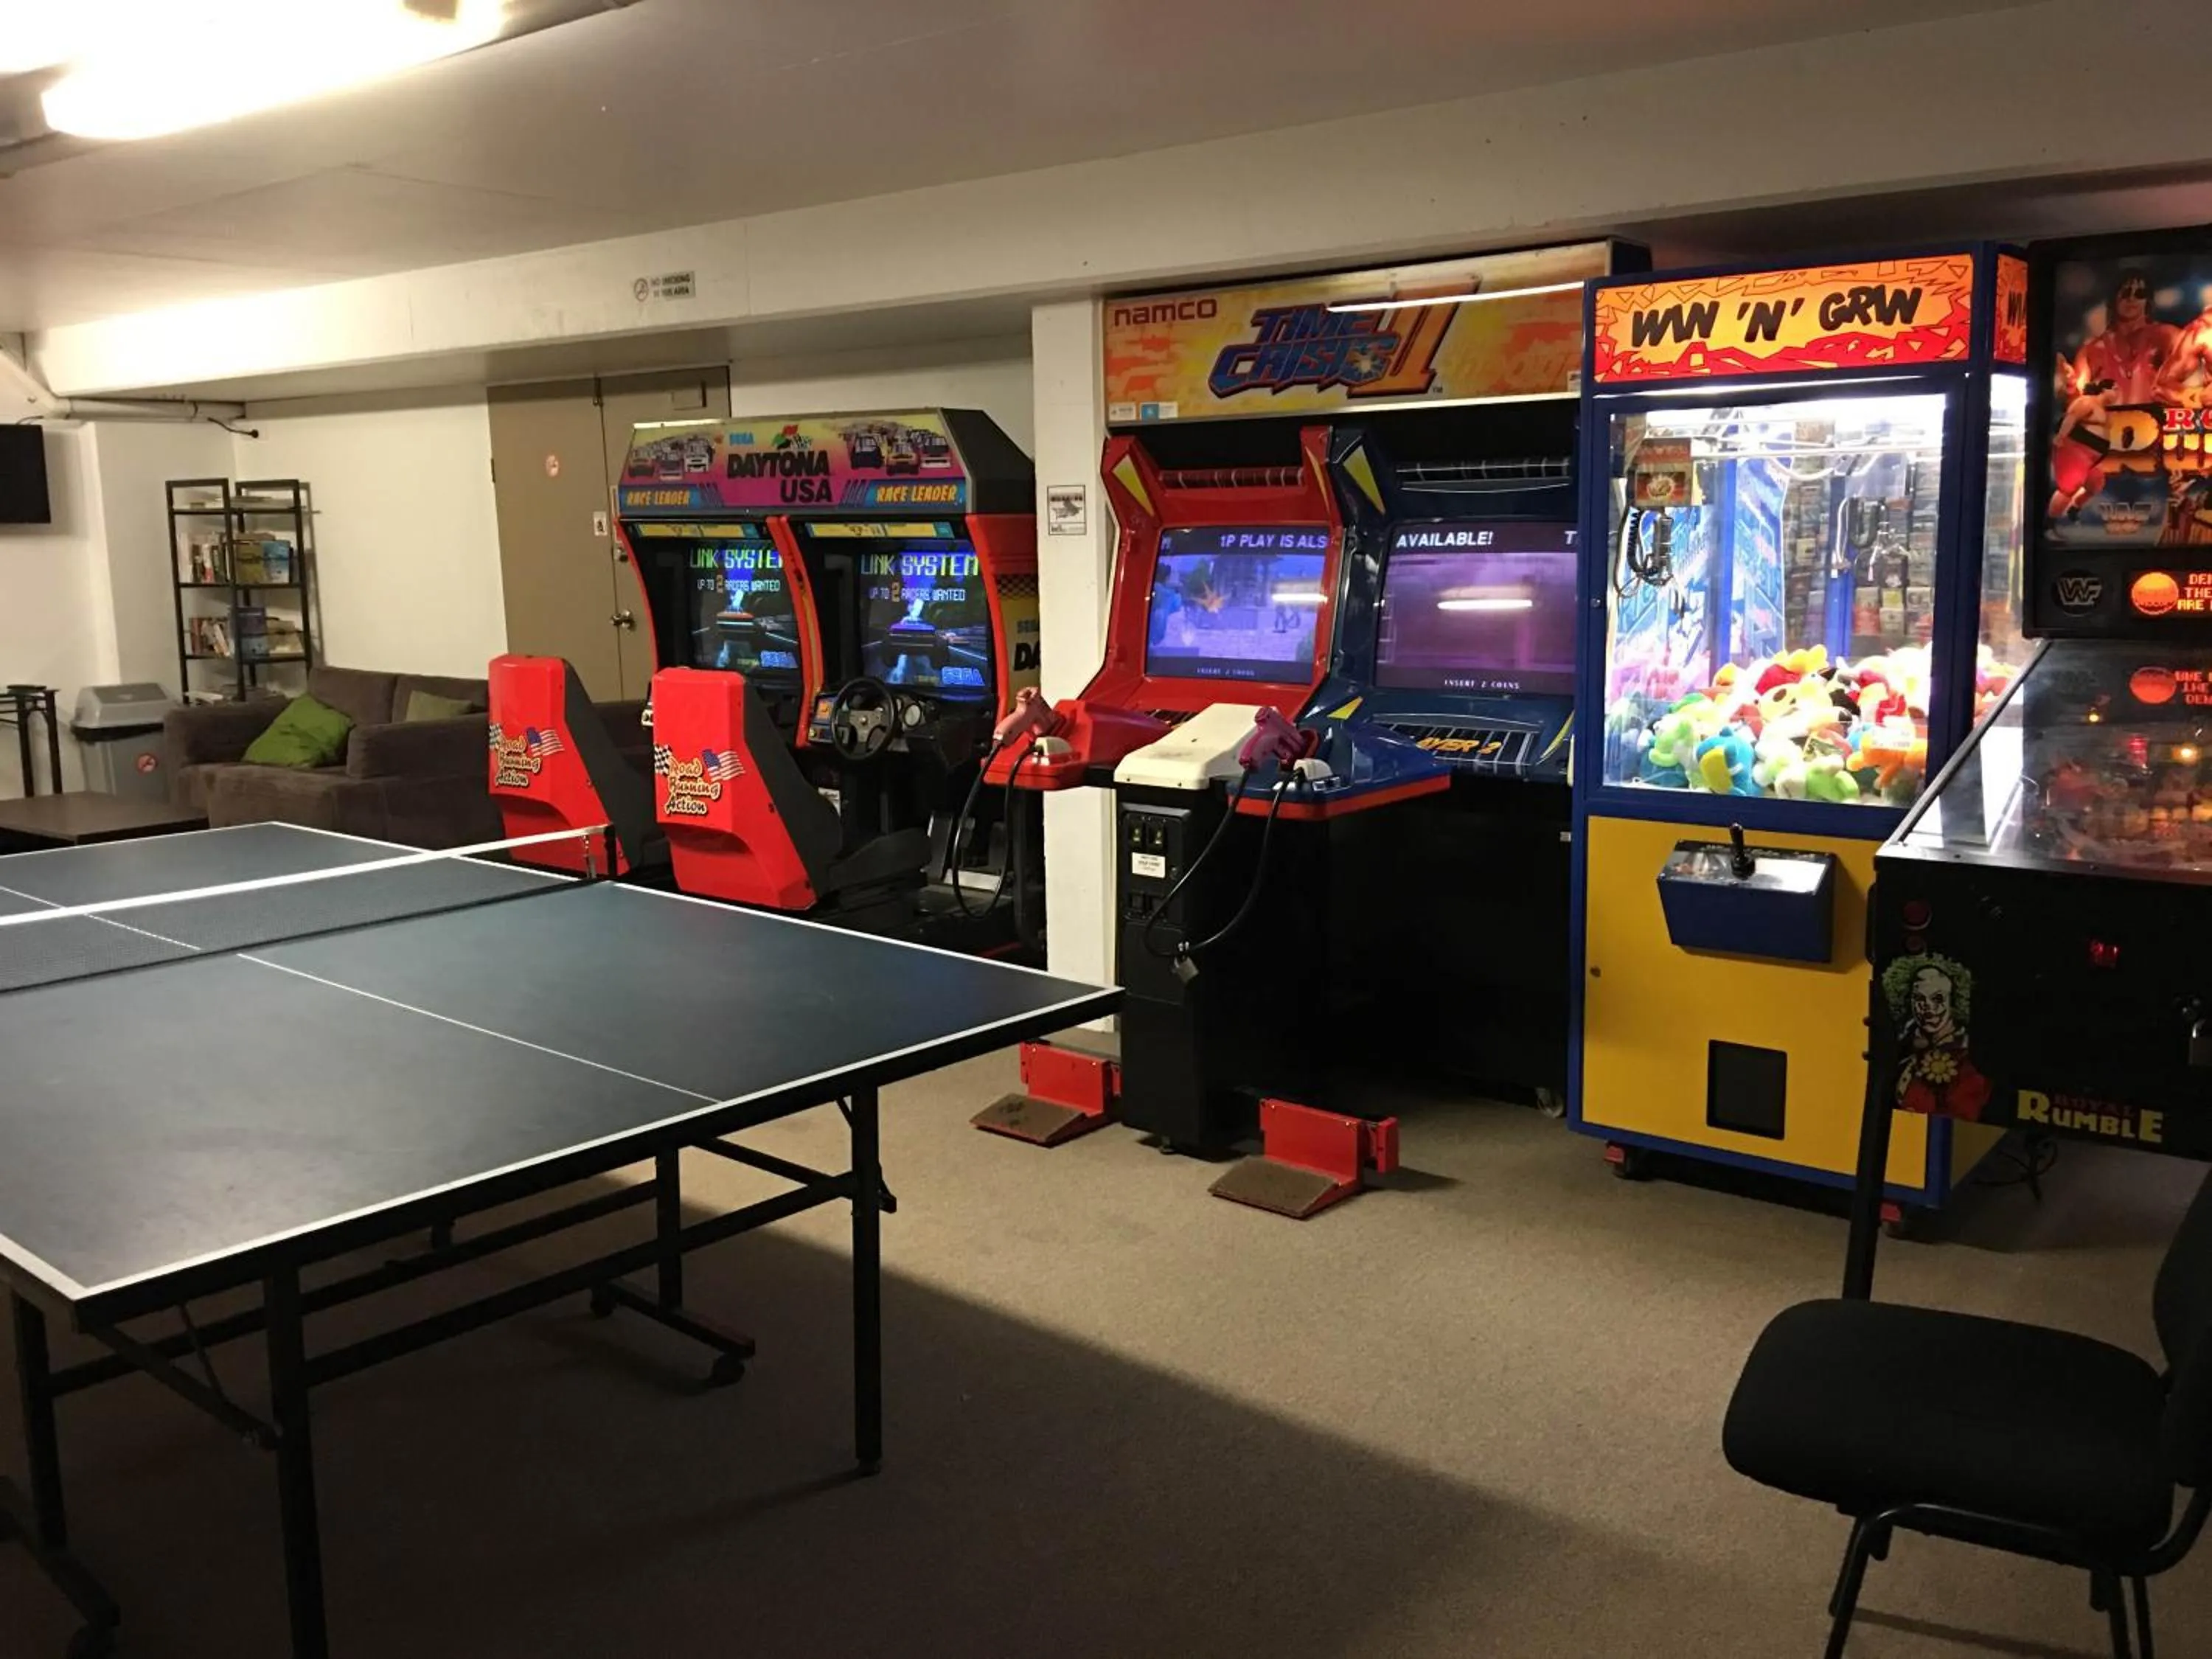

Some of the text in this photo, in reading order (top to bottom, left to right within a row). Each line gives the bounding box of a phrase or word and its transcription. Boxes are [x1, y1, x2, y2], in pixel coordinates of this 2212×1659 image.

[1114, 298, 1217, 327] namco
[1251, 296, 1389, 344] TIME
[1208, 335, 1399, 398] CRISIS
[727, 450, 832, 479] DAYTONA
[627, 490, 690, 507] RACE LEADER
[781, 479, 833, 503] USA
[877, 484, 958, 502] RACE LEADER
[1220, 535, 1237, 548] 1P
[1239, 535, 1275, 548] PLAY
[1279, 535, 1293, 547] IS
[1396, 531, 1494, 548] AVAILABLE!
[690, 548, 719, 568] LINK
[861, 554, 979, 577] LINK SYSTEM
[891, 581, 900, 602] 2
[933, 588, 966, 602] WANTED
[2177, 599, 2205, 611] ARE
[1444, 679, 1475, 688] INSERT
[664, 793, 707, 814] Action
[2017, 1088, 2165, 1144] RUMBLE
